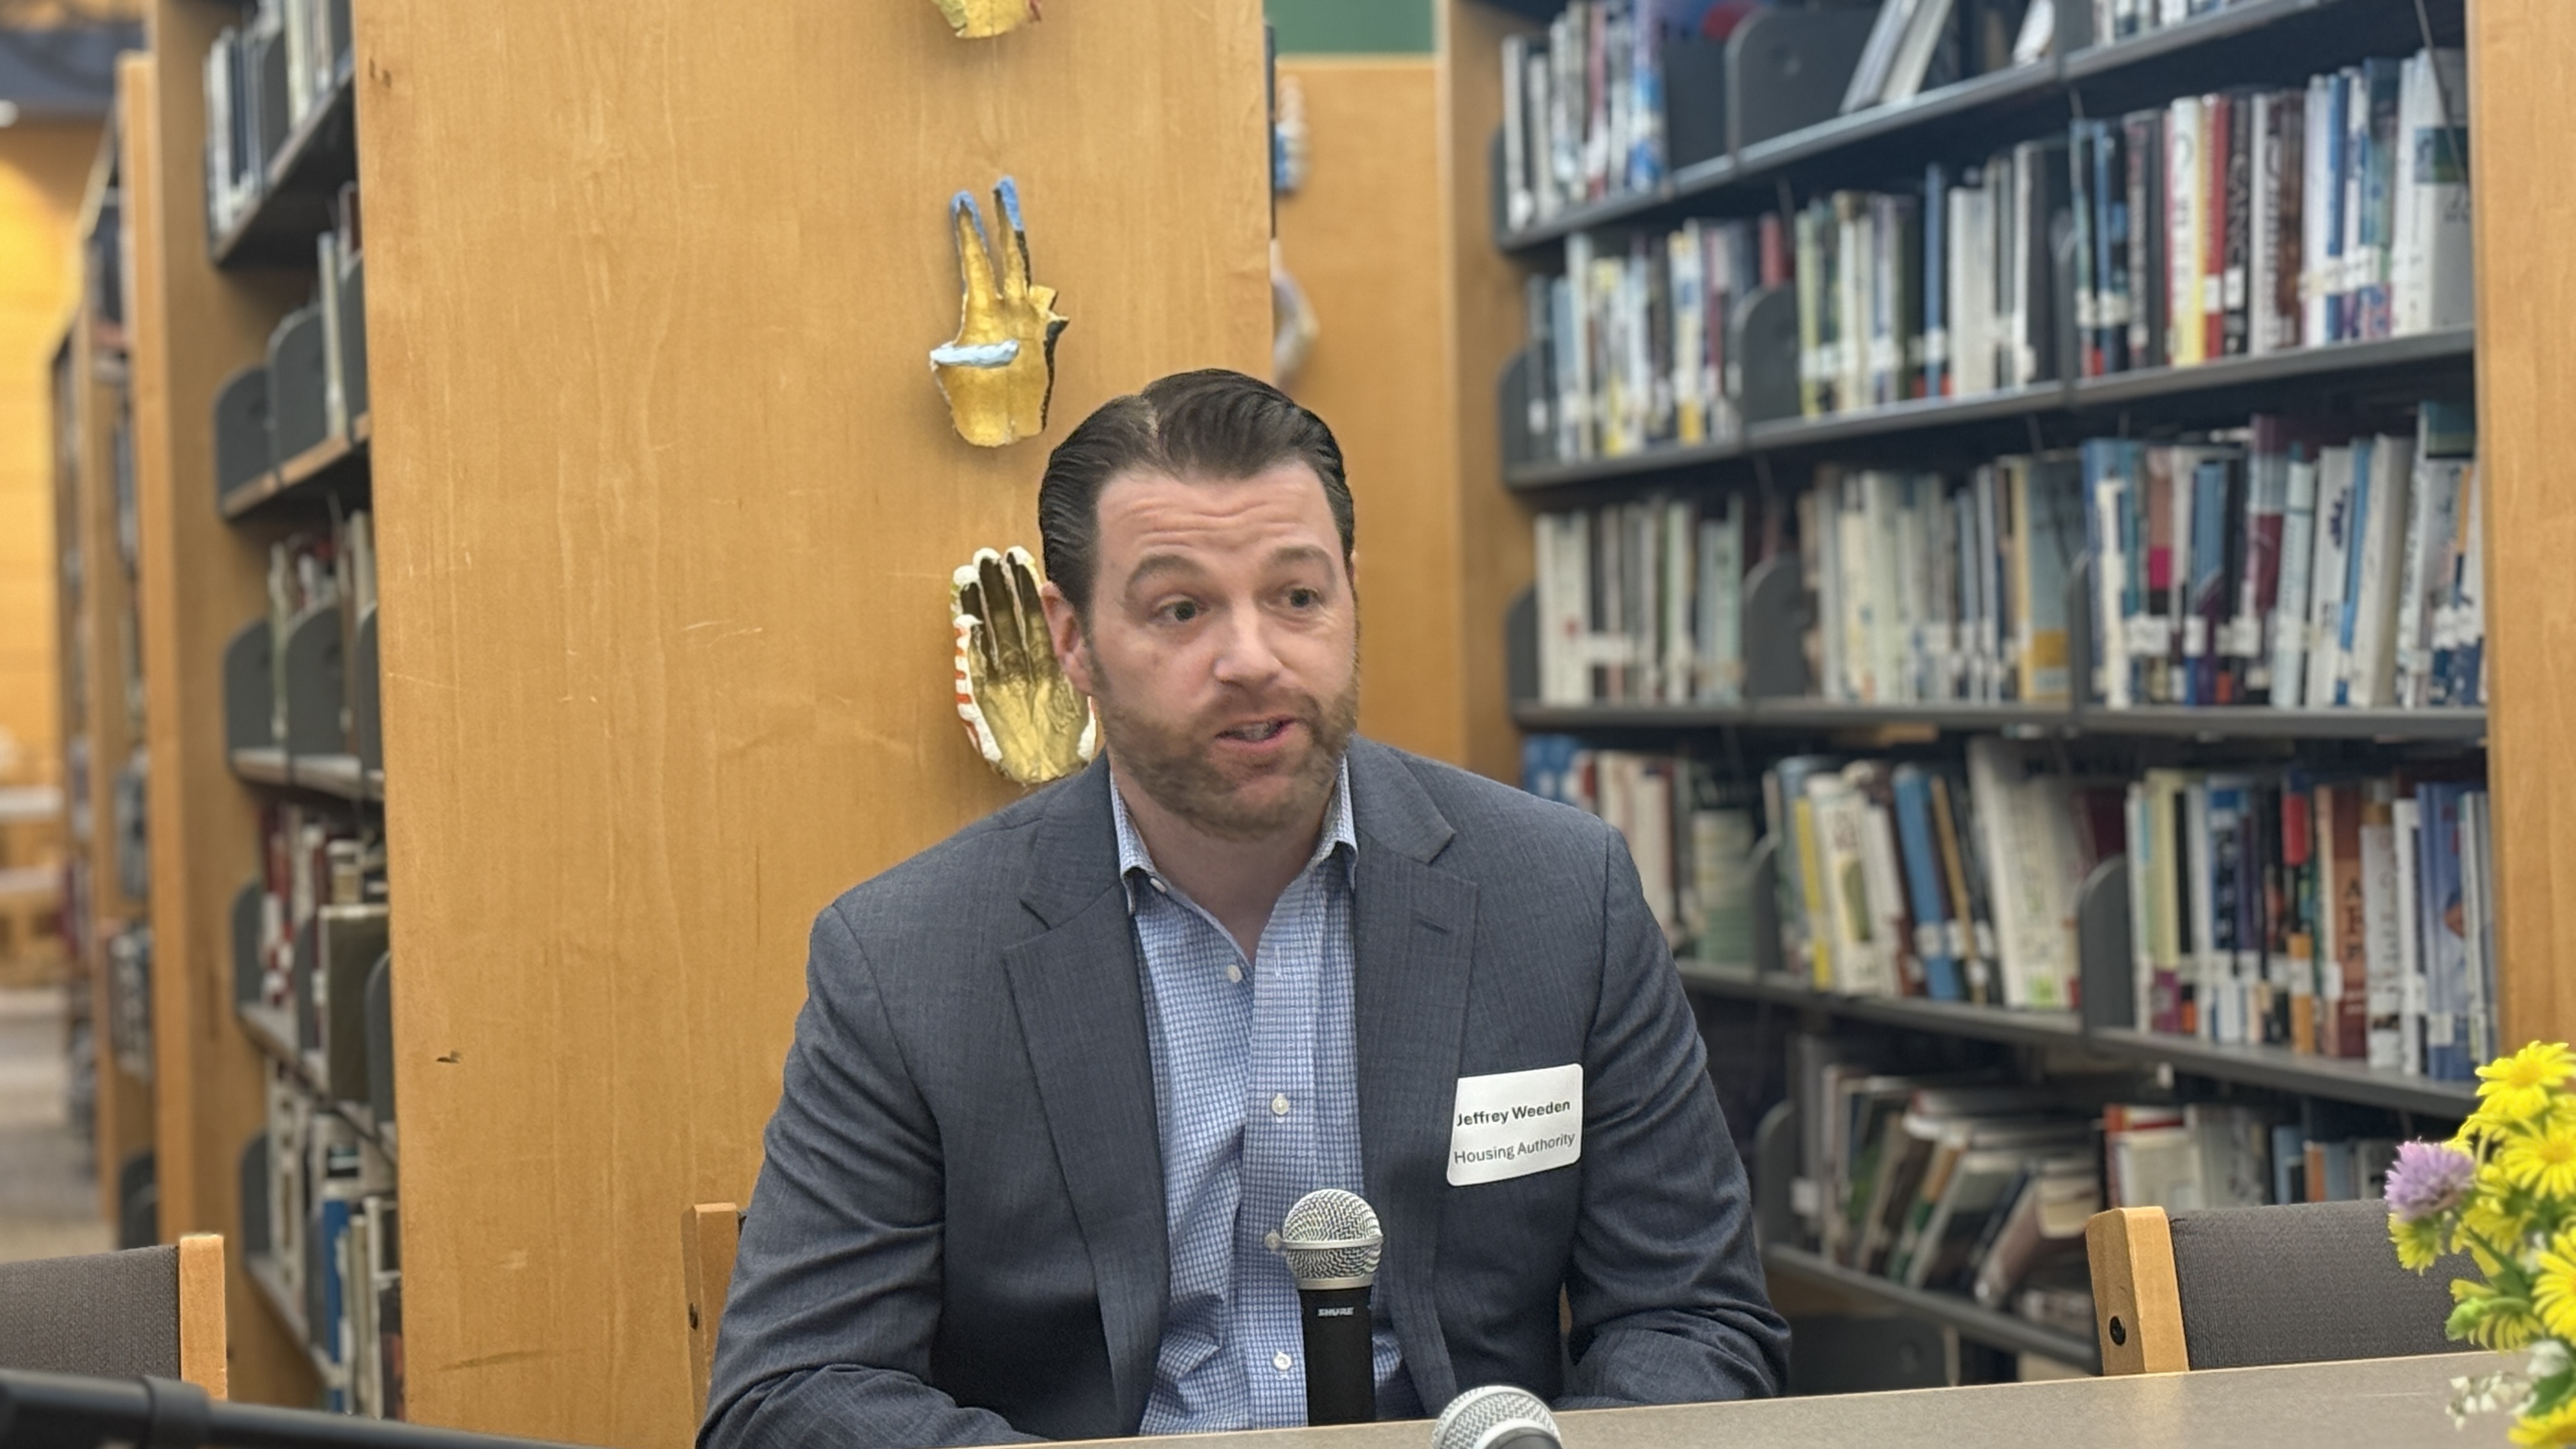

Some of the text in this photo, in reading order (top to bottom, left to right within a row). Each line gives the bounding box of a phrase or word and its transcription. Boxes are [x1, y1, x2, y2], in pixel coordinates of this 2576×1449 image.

[1457, 1100, 1570, 1126] Jeffrey Weeden
[1454, 1133, 1575, 1165] Housing Authority
